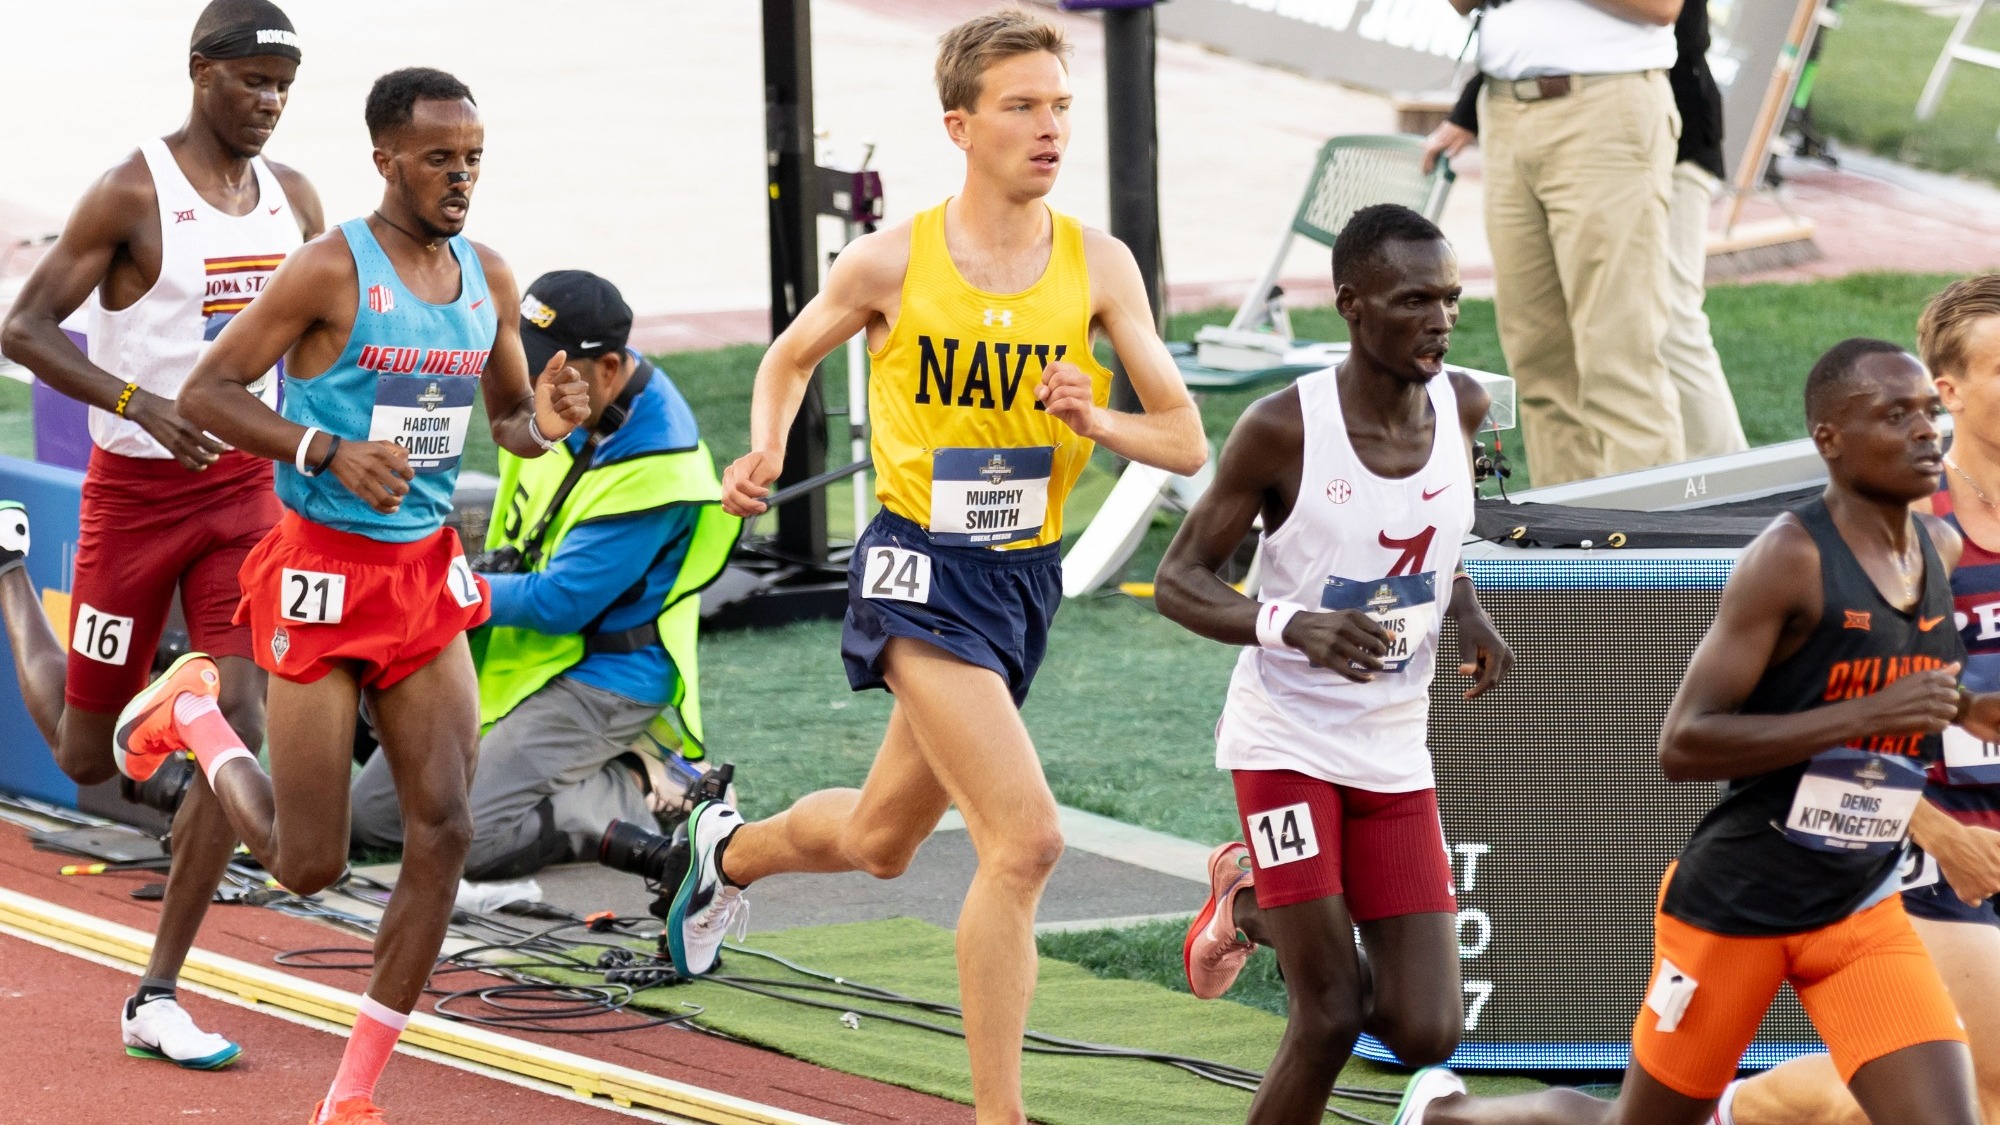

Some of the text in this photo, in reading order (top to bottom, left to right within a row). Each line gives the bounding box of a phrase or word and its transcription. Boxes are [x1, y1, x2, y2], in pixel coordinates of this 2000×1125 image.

[357, 345, 420, 374] NEW
[915, 335, 1067, 411] NAVY
[403, 417, 450, 431] HABTOM
[394, 435, 450, 455] SAMUEL
[966, 489, 1023, 506] MURPHY
[1326, 479, 1352, 504] SEC
[1684, 475, 1707, 499] A4
[965, 508, 1020, 530] SMITH
[871, 549, 920, 598] 24
[289, 574, 330, 621] 21
[86, 614, 121, 660] 16
[1840, 792, 1882, 813] DENIS
[1258, 809, 1306, 862] 14
[1799, 806, 1902, 838] KIPNGETICH
